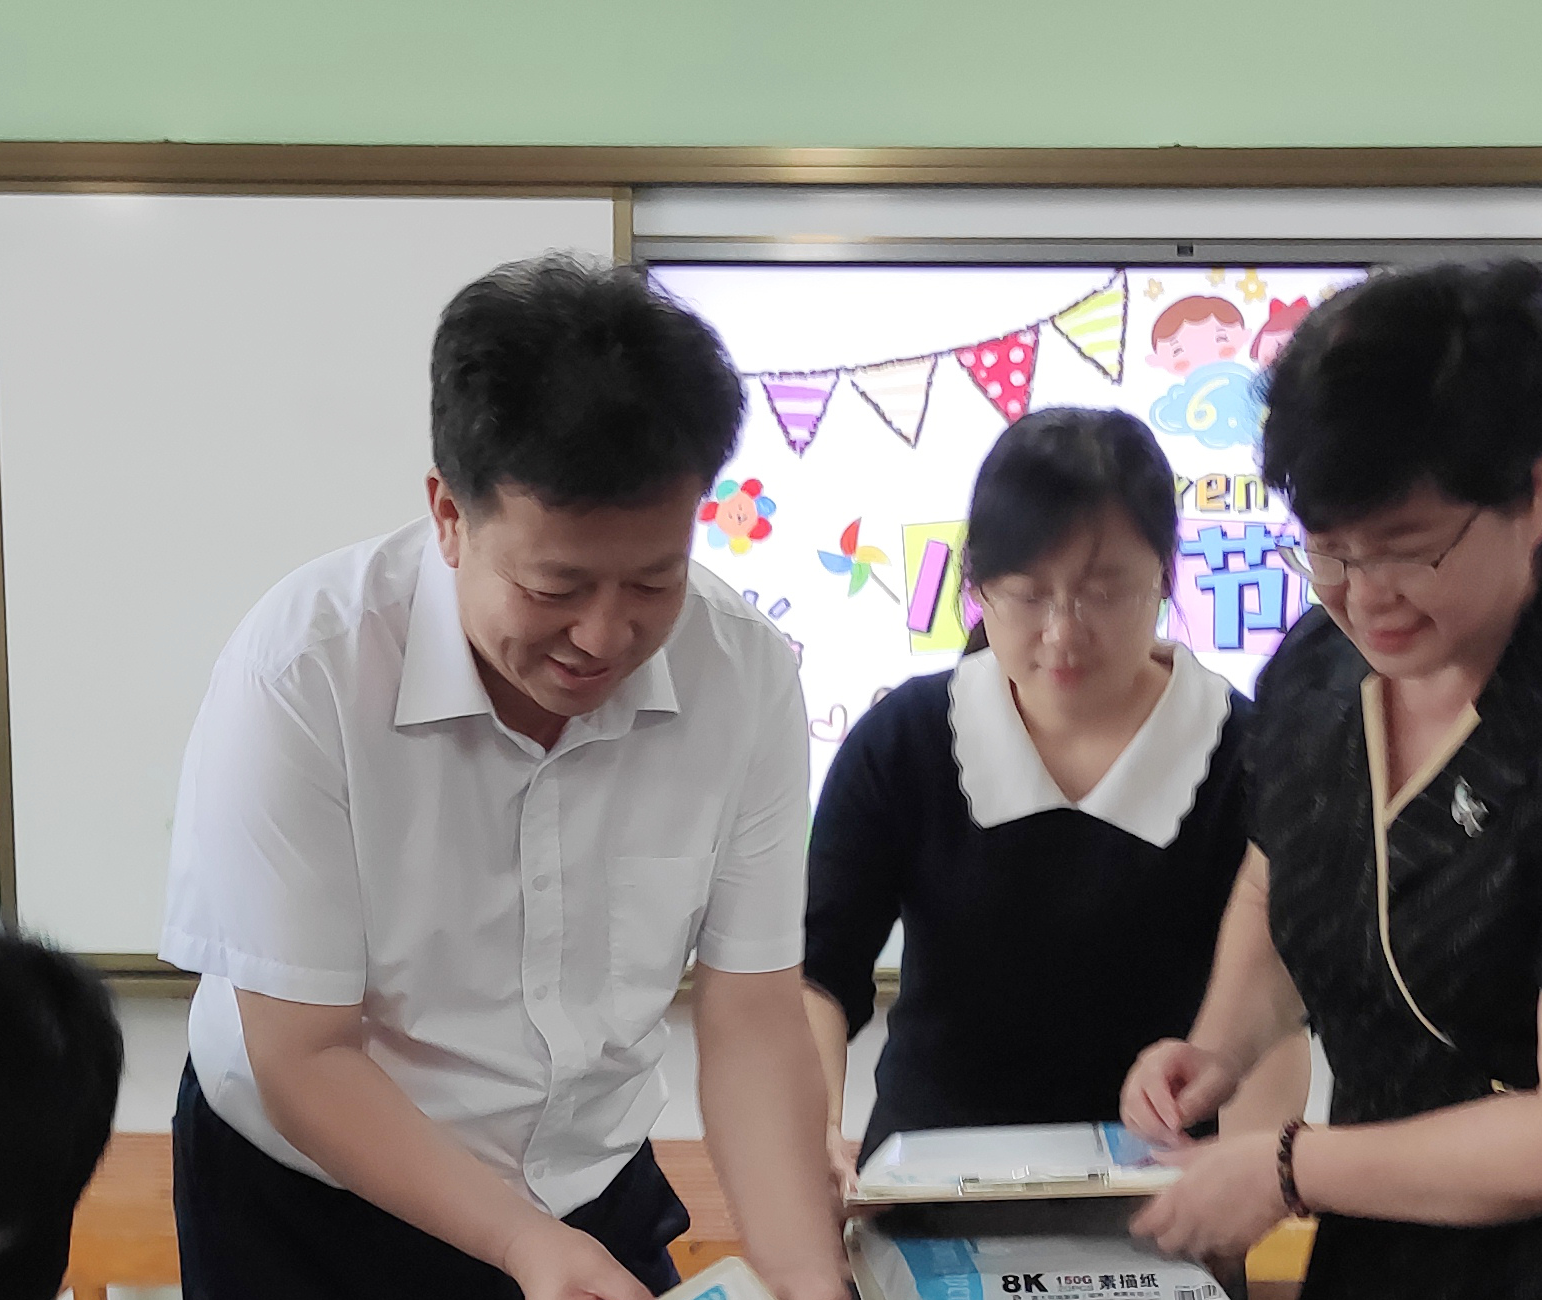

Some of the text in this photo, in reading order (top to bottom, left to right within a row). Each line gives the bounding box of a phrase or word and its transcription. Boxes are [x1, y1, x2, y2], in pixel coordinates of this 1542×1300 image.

[1002, 1273, 1049, 1293] 8K
[1098, 1273, 1159, 1290] 素描纸
